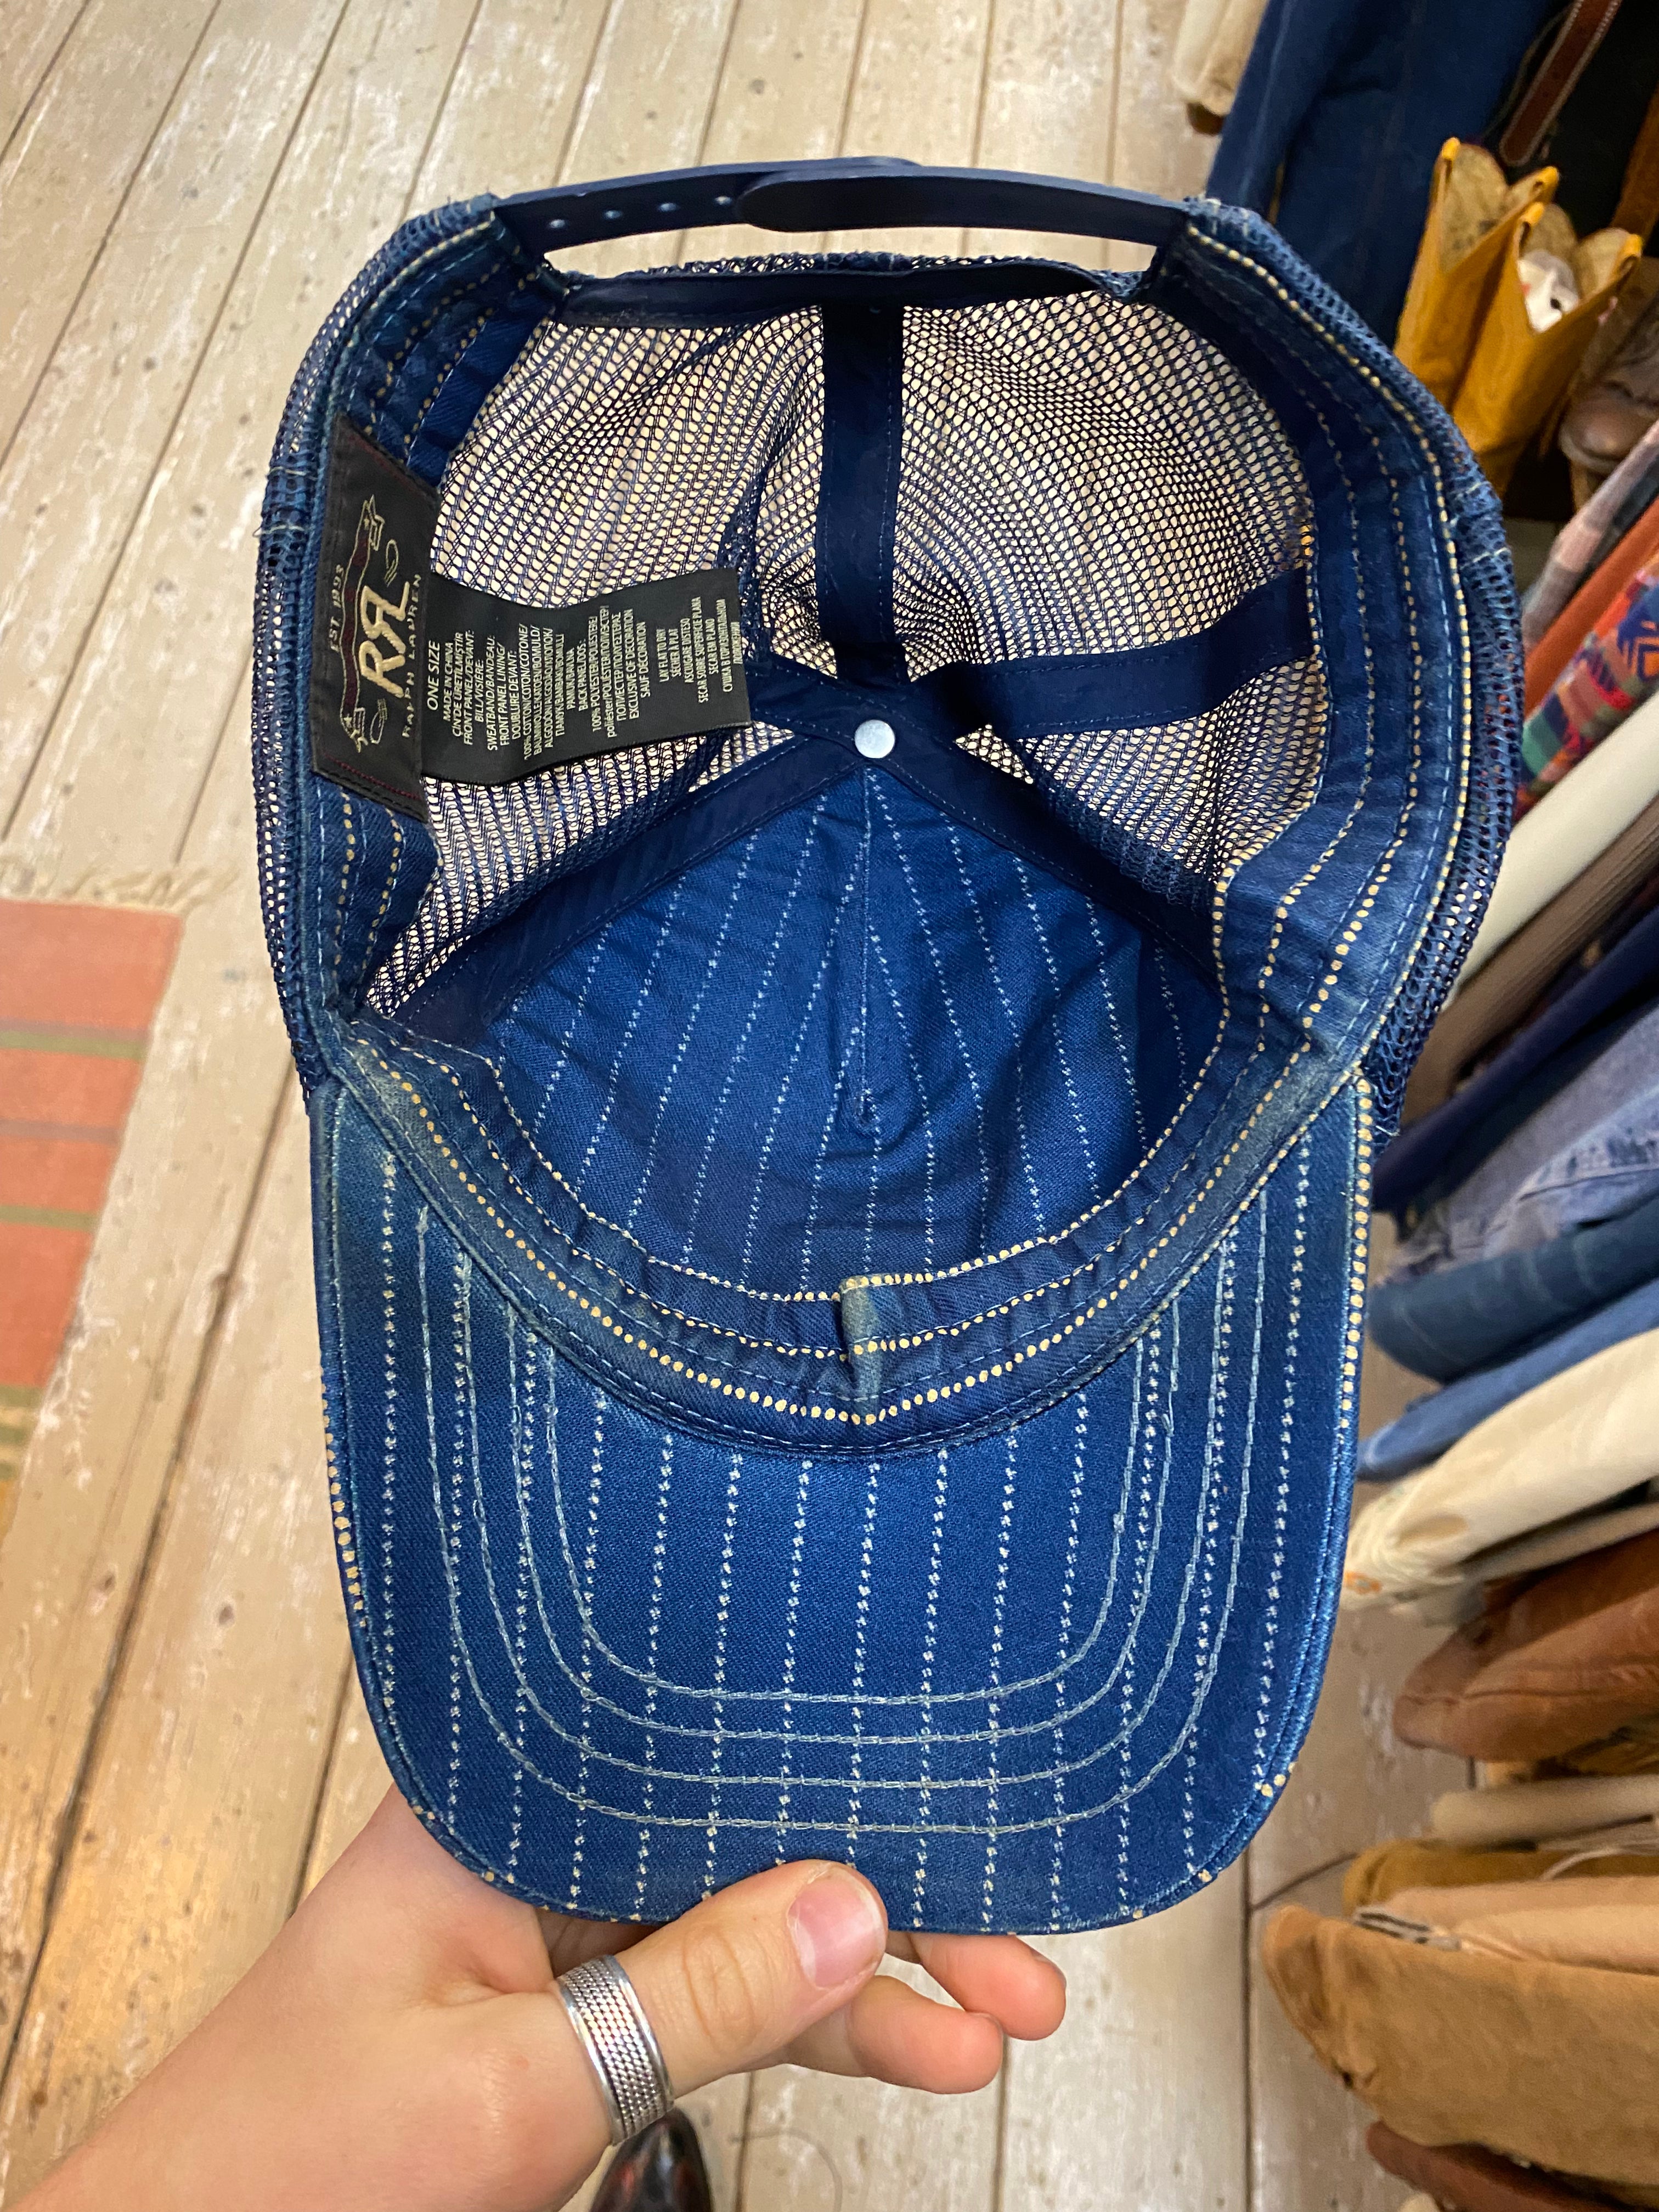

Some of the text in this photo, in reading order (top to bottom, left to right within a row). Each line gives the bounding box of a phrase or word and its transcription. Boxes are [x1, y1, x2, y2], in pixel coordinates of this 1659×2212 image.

[669, 628, 679, 644] PLAT
[680, 618, 691, 644] DISTESO
[691, 597, 702, 618] PLANA
[705, 618, 715, 640] PLANO
[402, 574, 422, 737] RALPH LAUREN
[427, 640, 440, 710] ONE SIZE
[443, 642, 453, 721] MADE IN CHINA
[624, 609, 640, 719] EXCLUSIVE OF DECORATION
[636, 622, 651, 698] SAUF DÉCORATION
[656, 629, 669, 682] LAY FLAT TO DRY
[696, 656, 707, 678] SOBRE
[708, 653, 719, 674] SECAR
[464, 630, 474, 745] FRONT PANEL/DEVANT:
[475, 659, 484, 722] BILL/VISIÈRE:
[486, 635, 498, 751] SWEATBAND/BANDEAU:
[497, 642, 510, 746] FRONT PANEL LINING/
[507, 650, 521, 739] DOUBLURE DEVANT:
[519, 623, 532, 760] 100% COTTON/COTON/COTONE/
[578, 688, 588, 711] BACK
[697, 680, 708, 703] SECAR
[592, 708, 602, 732] 100%
